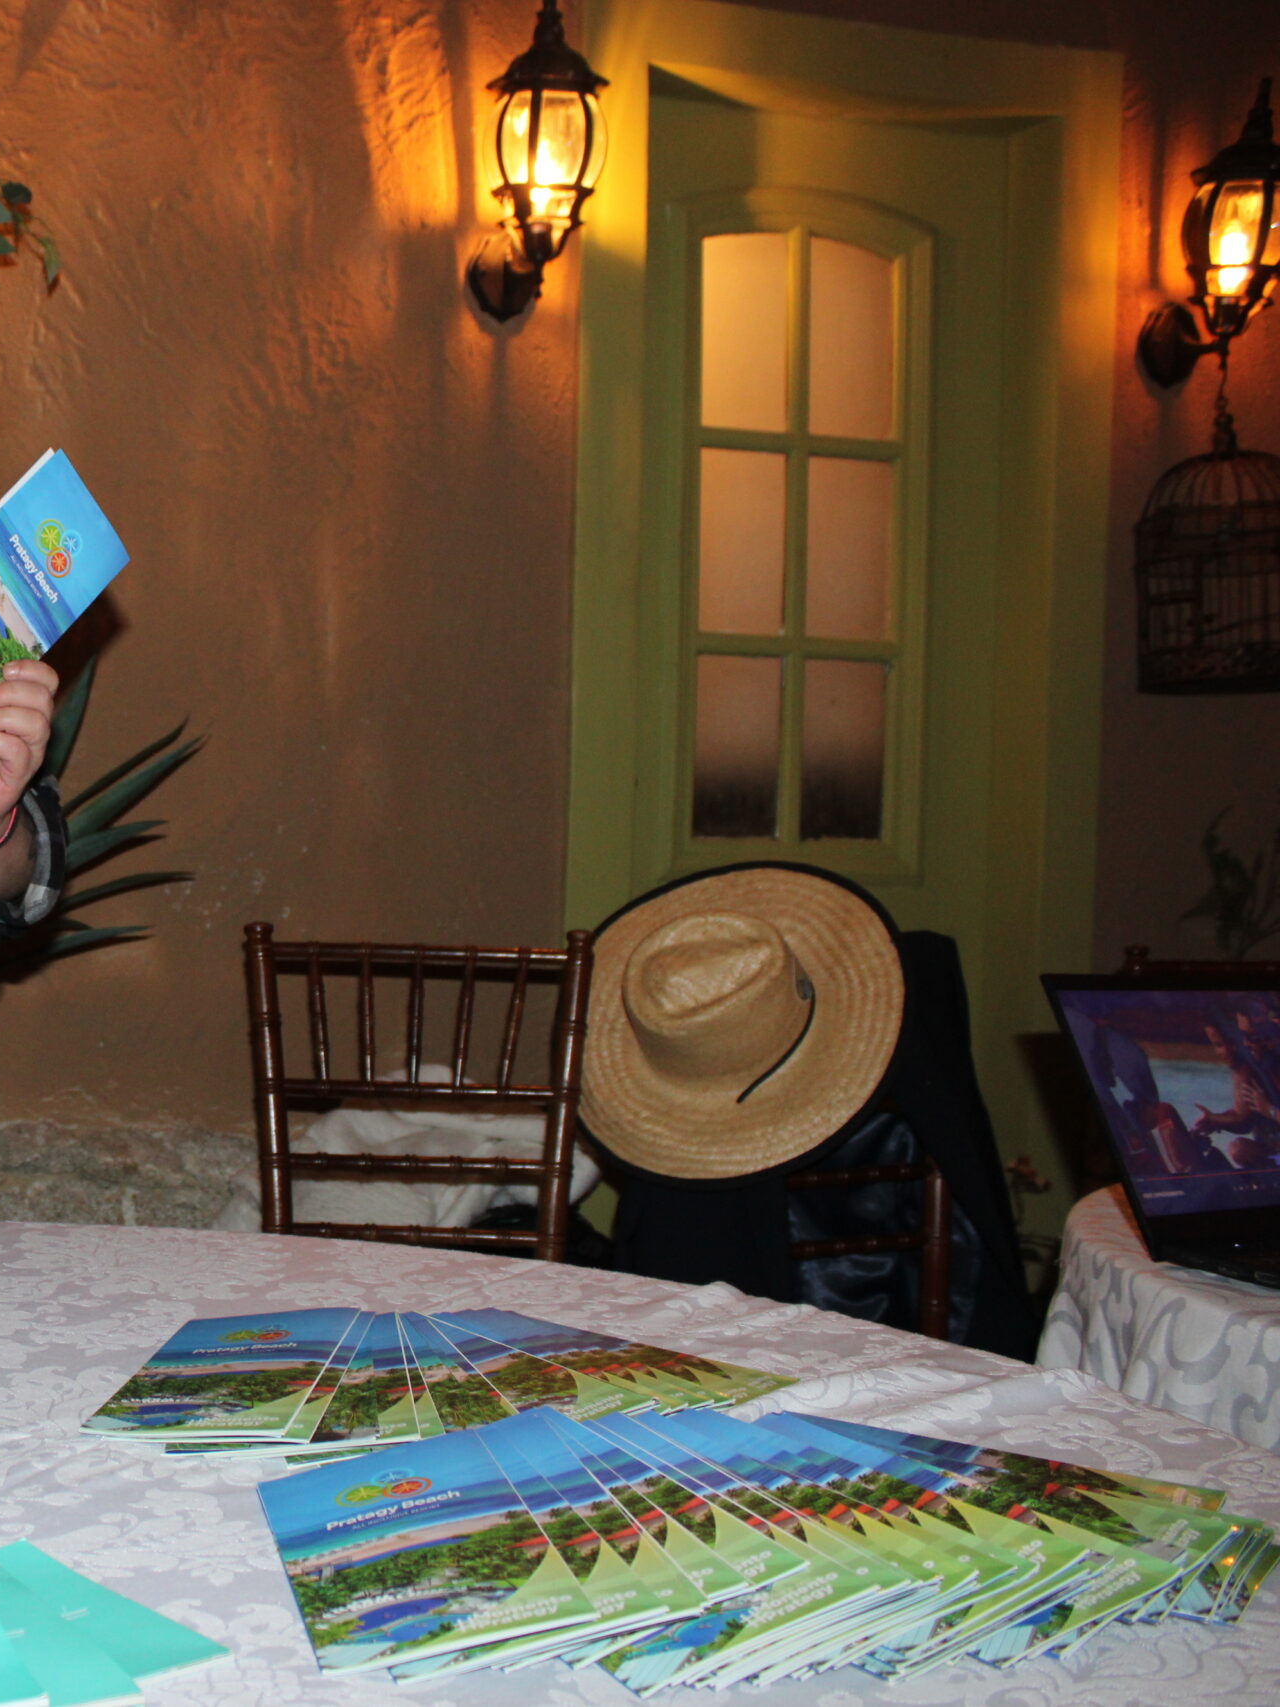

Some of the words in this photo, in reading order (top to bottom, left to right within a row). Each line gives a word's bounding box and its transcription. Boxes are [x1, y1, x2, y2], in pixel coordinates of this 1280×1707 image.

[9, 534, 38, 574] Pratagy
[34, 571, 58, 604] Beach
[192, 1346, 251, 1354] Pratagy
[251, 1342, 298, 1350] Beach
[326, 1505, 398, 1531] Pratagy
[401, 1490, 461, 1510] Beach
